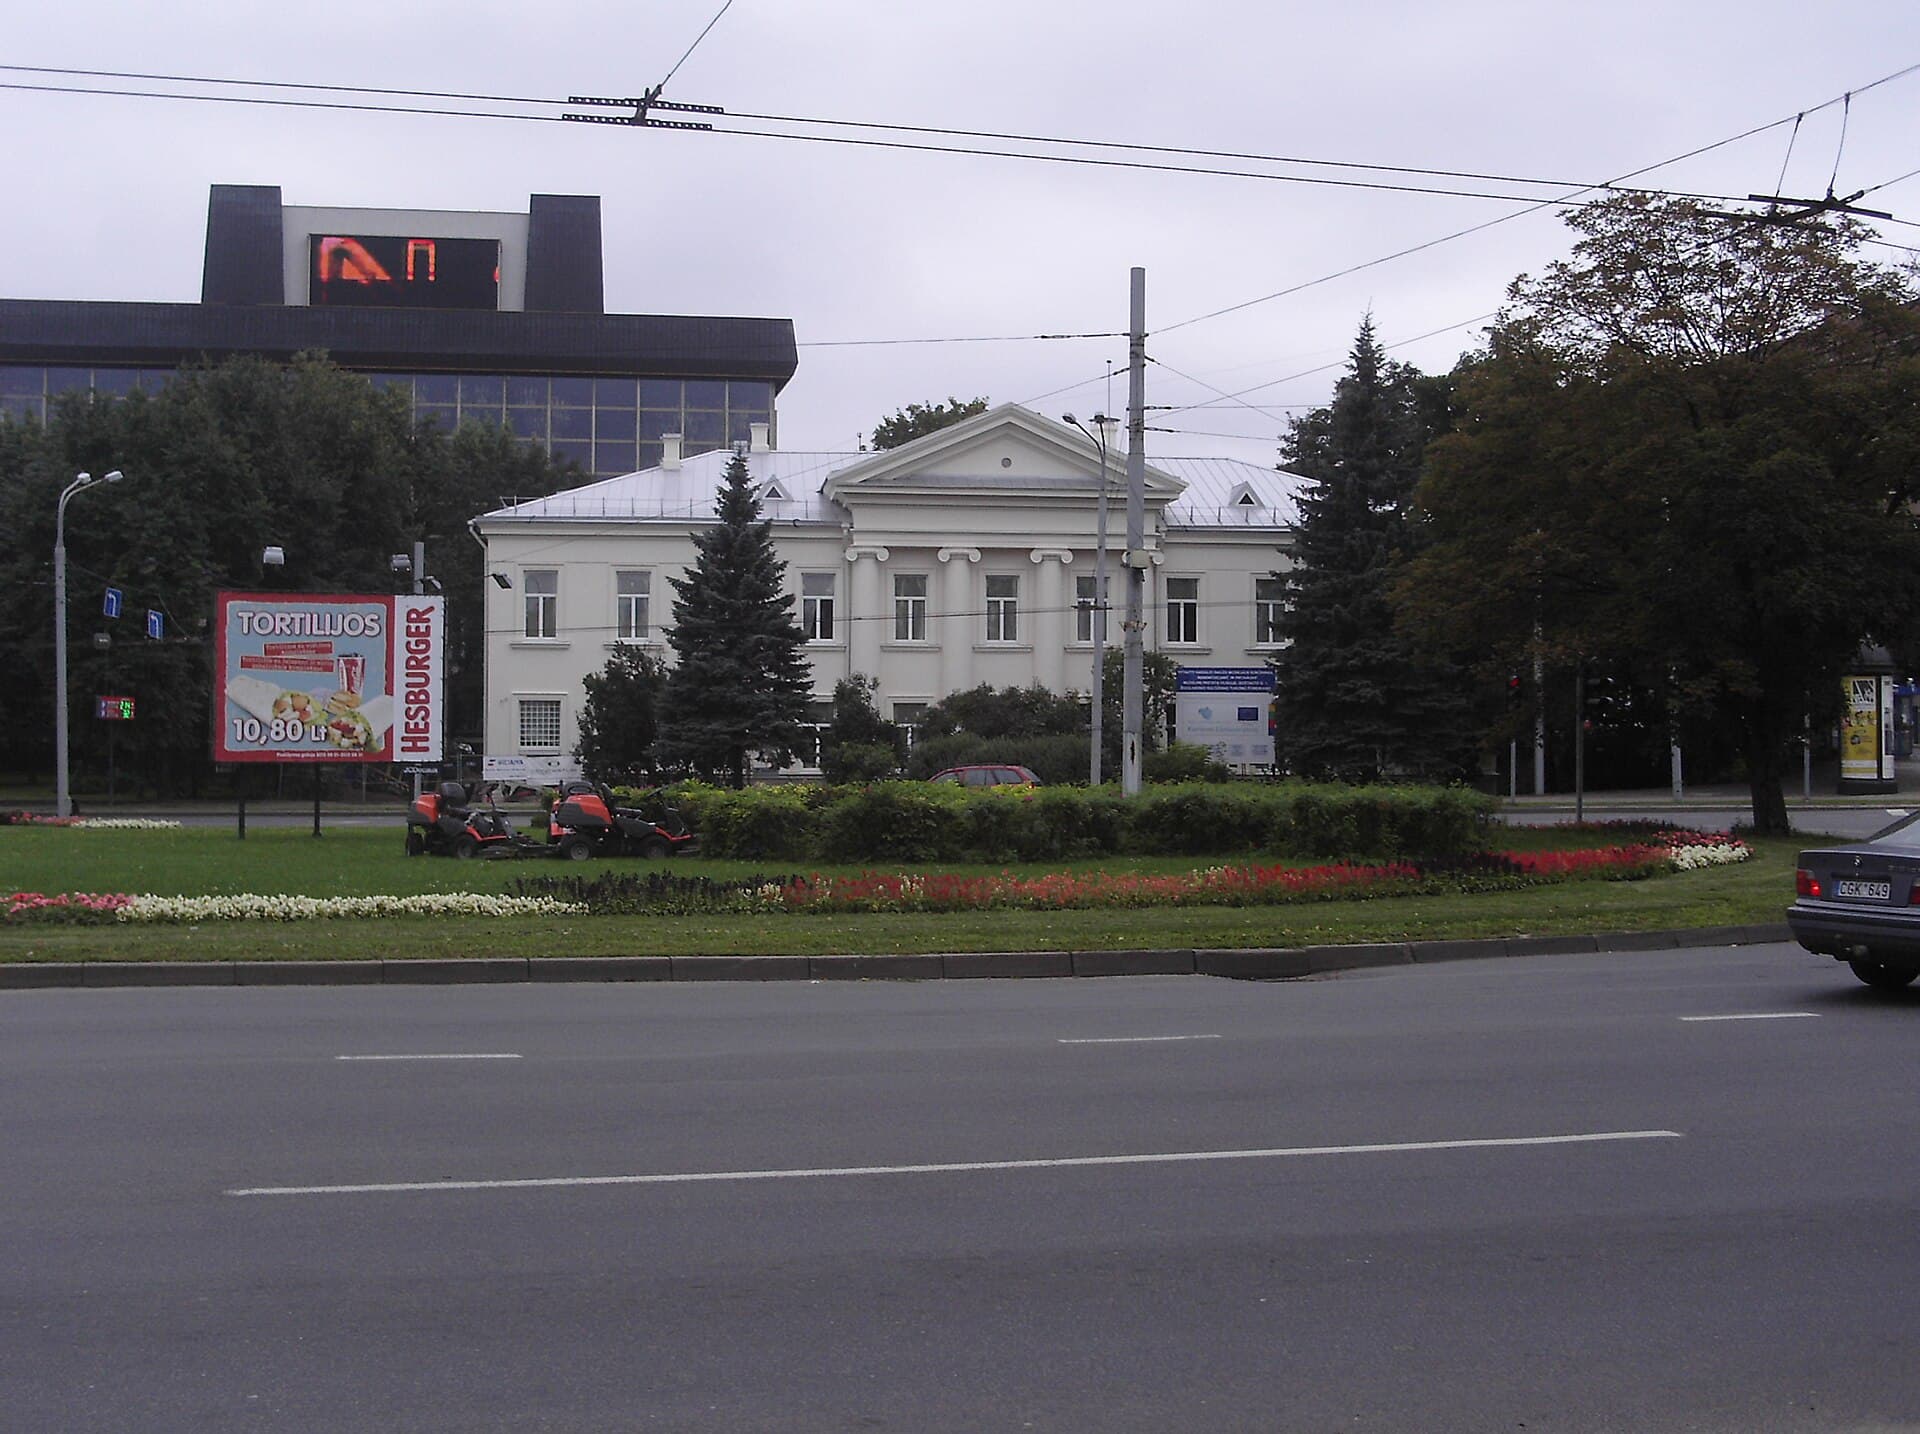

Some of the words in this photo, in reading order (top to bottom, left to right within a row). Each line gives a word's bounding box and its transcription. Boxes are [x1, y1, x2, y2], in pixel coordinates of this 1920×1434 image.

[238, 611, 381, 637] TORTILIJOS
[401, 606, 435, 752] HESBURGER
[233, 718, 304, 745] 10,80
[311, 725, 328, 741] Lt
[1840, 882, 1861, 896] CGK
[1868, 883, 1889, 898] 649
